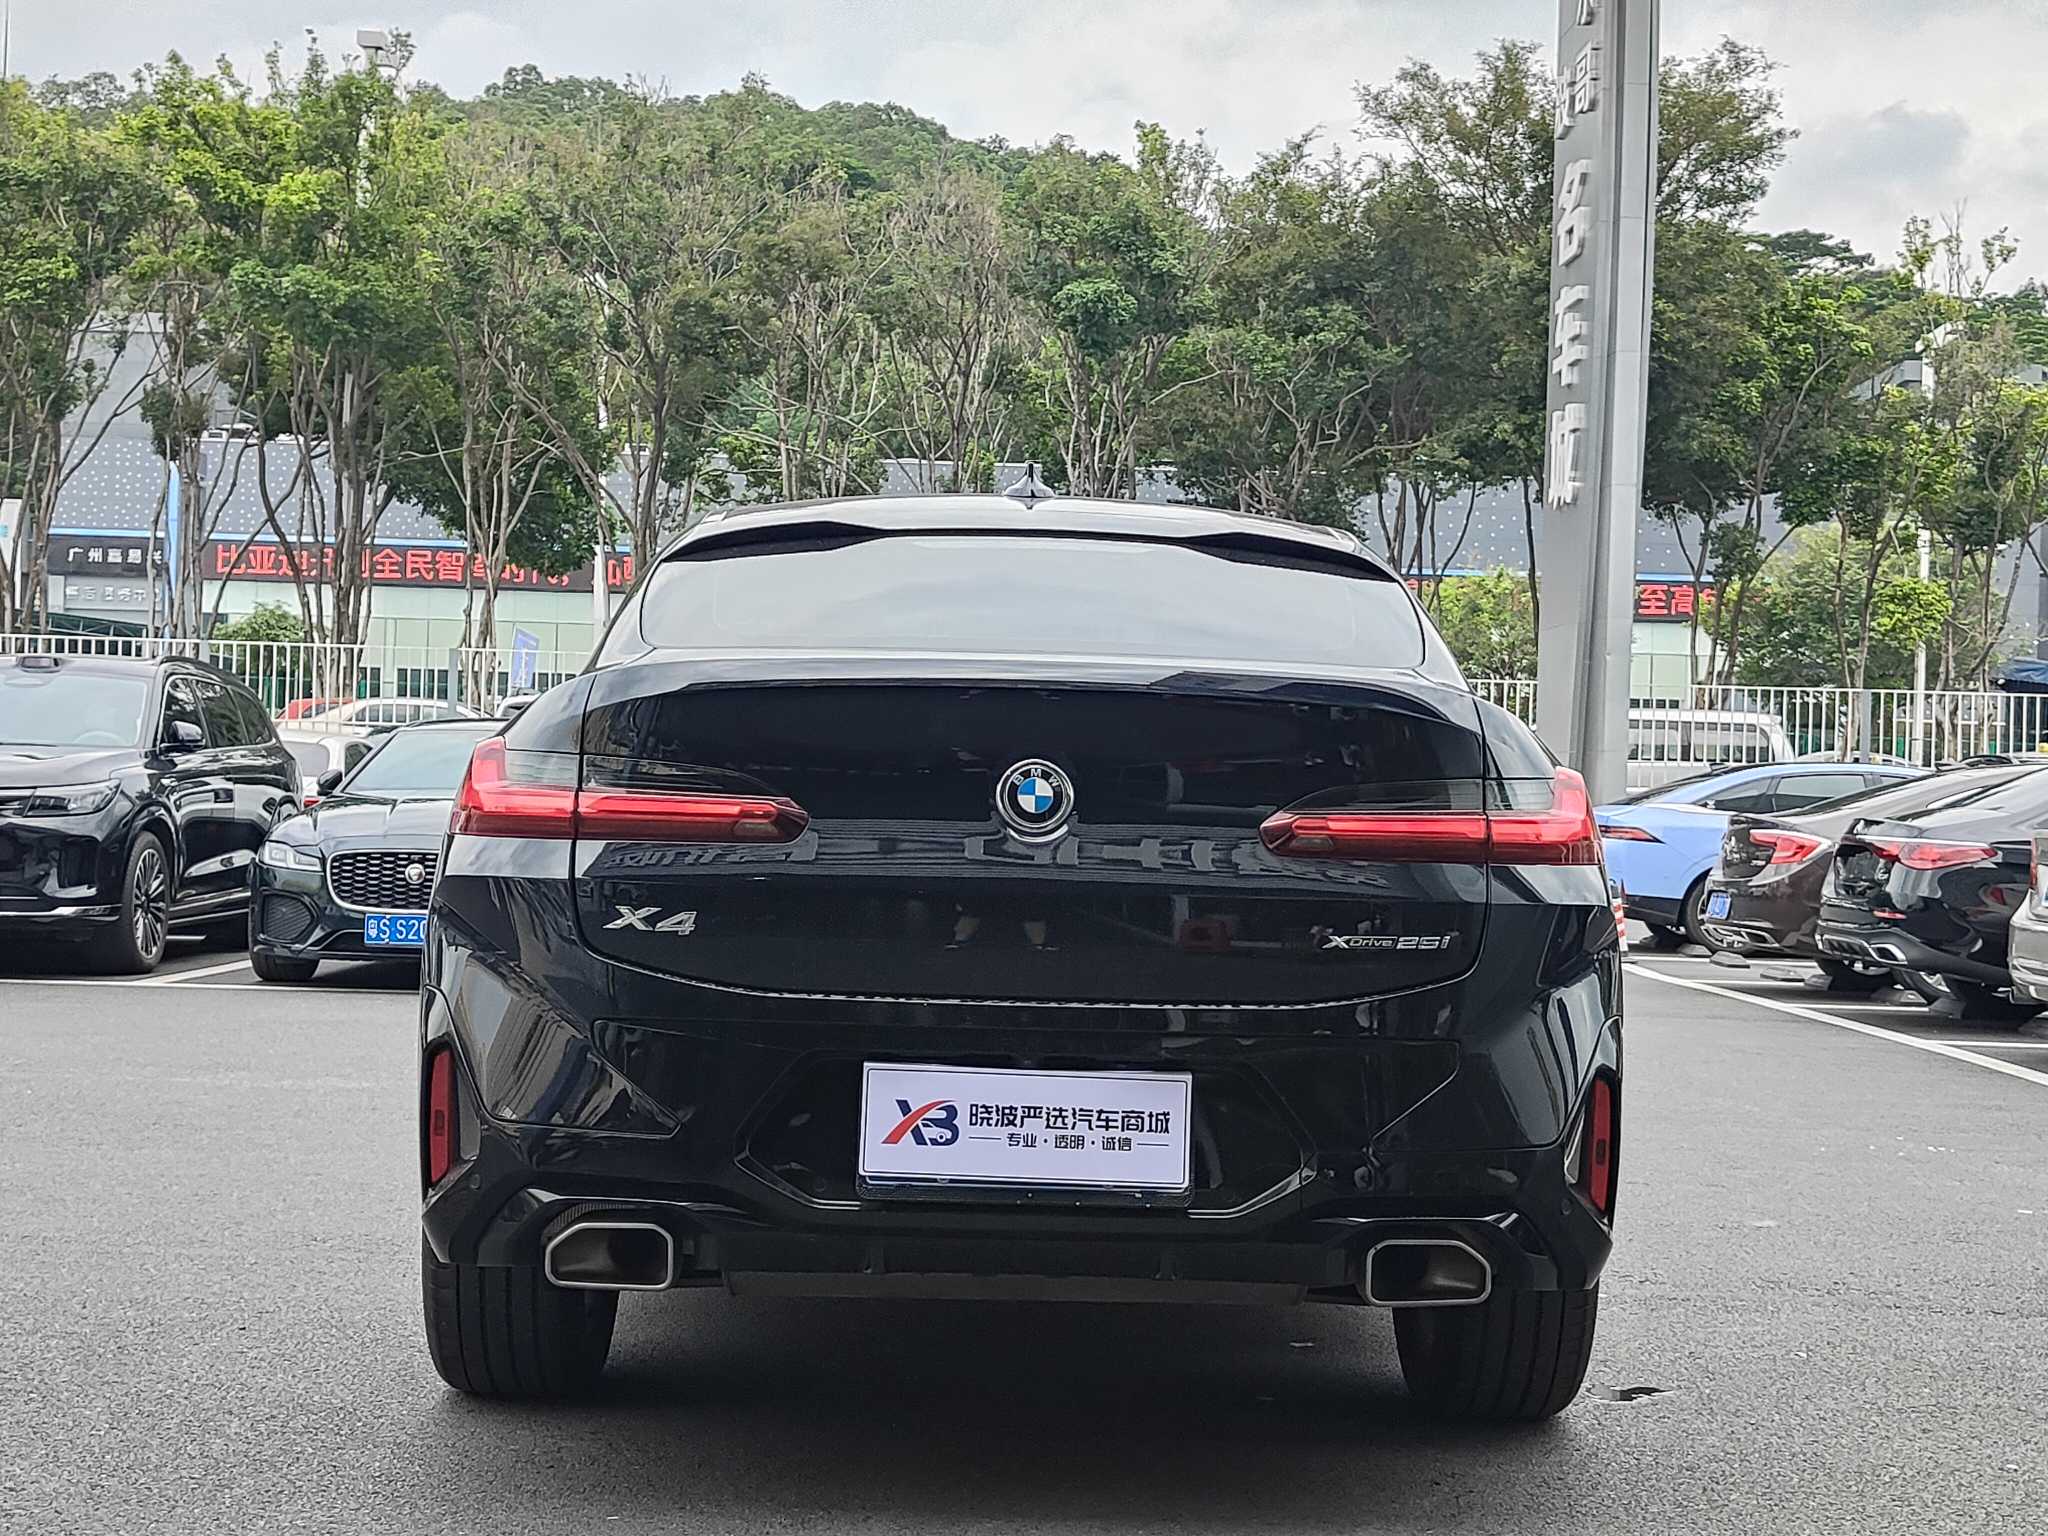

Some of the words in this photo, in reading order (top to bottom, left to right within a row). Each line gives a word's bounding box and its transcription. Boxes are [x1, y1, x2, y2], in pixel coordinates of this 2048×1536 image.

[1012, 768, 1062, 787] BMW
[602, 905, 698, 935] X4
[968, 1103, 1171, 1135] 晓波严选汽车商城
